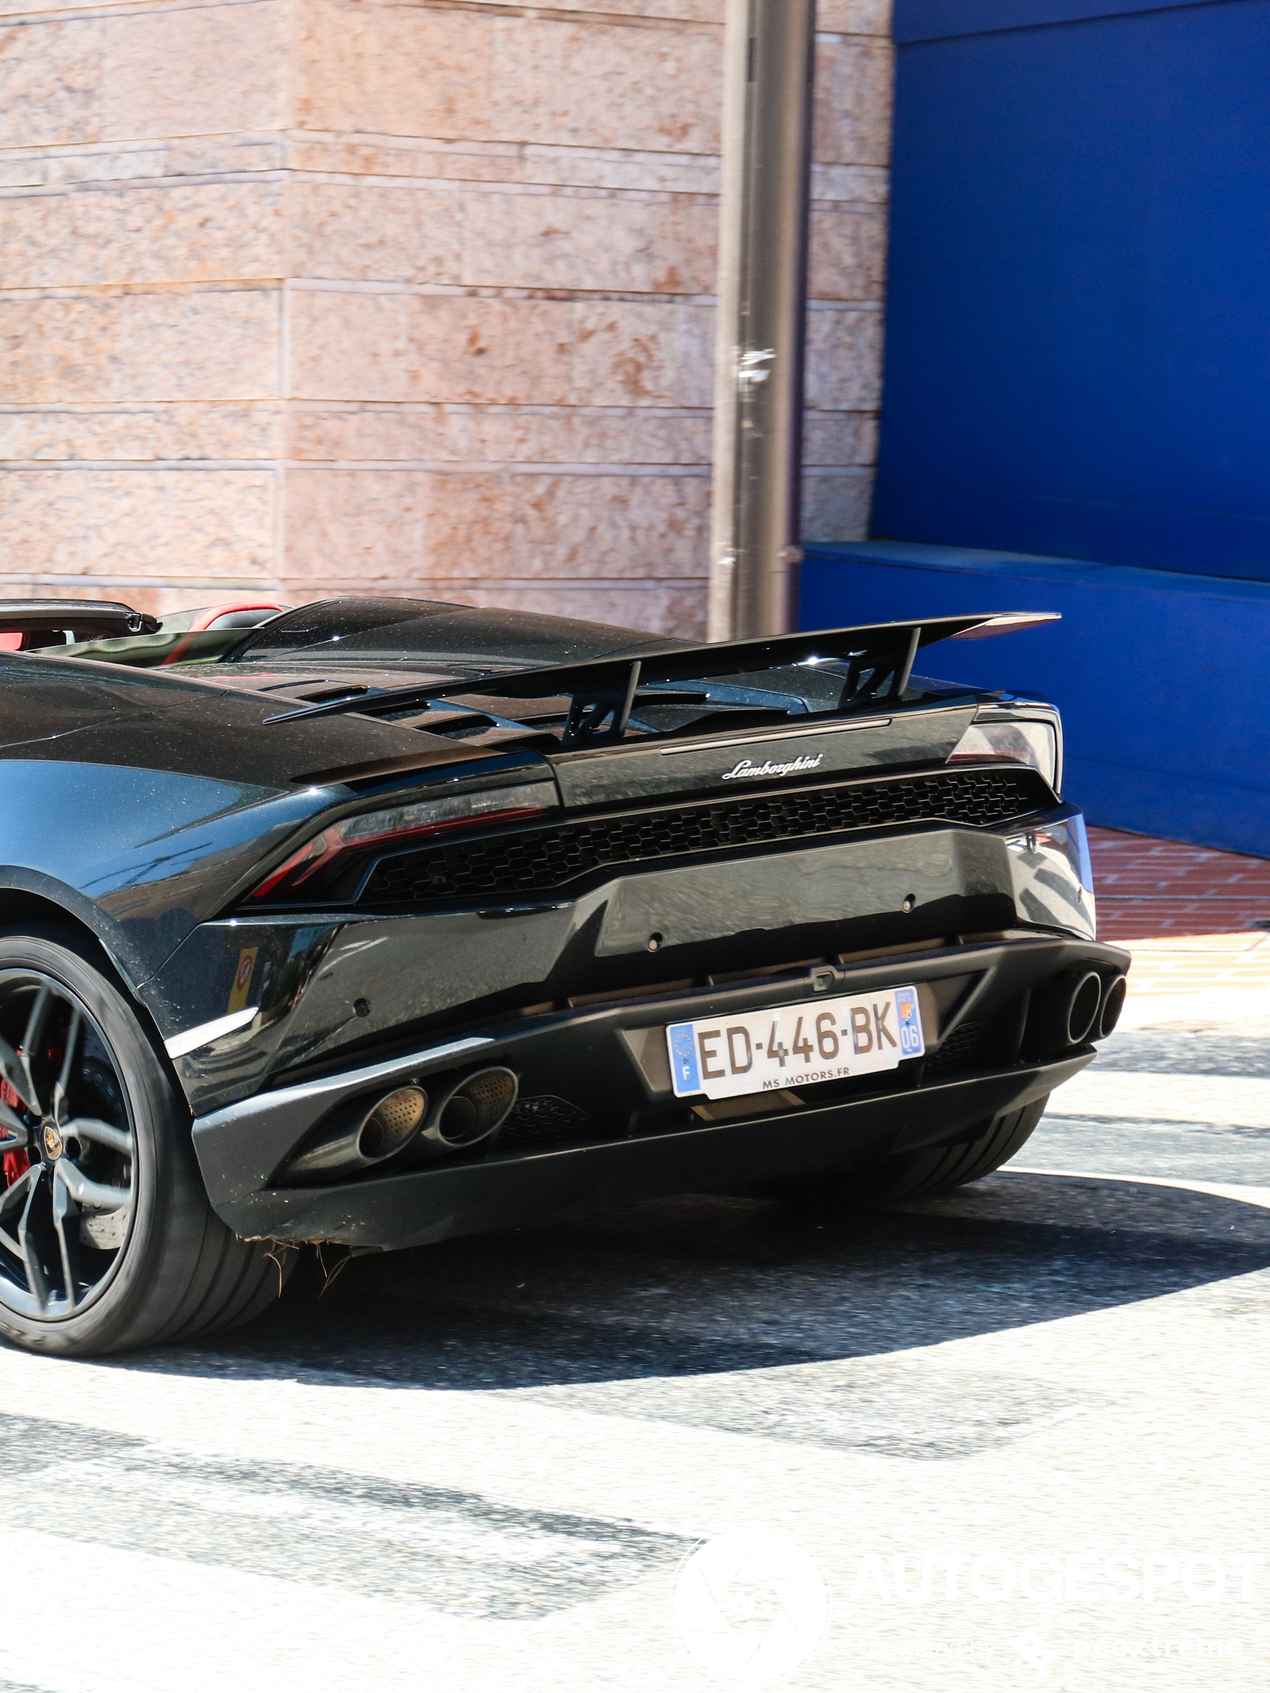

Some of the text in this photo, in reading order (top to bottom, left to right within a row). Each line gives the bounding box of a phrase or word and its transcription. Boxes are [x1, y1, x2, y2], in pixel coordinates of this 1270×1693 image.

[722, 753, 823, 780] Lamborghini
[697, 1001, 898, 1080] ED-446-BK
[900, 1025, 919, 1049] 06
[682, 1065, 691, 1081] F
[762, 1067, 850, 1090] MS MOTORS.FR
